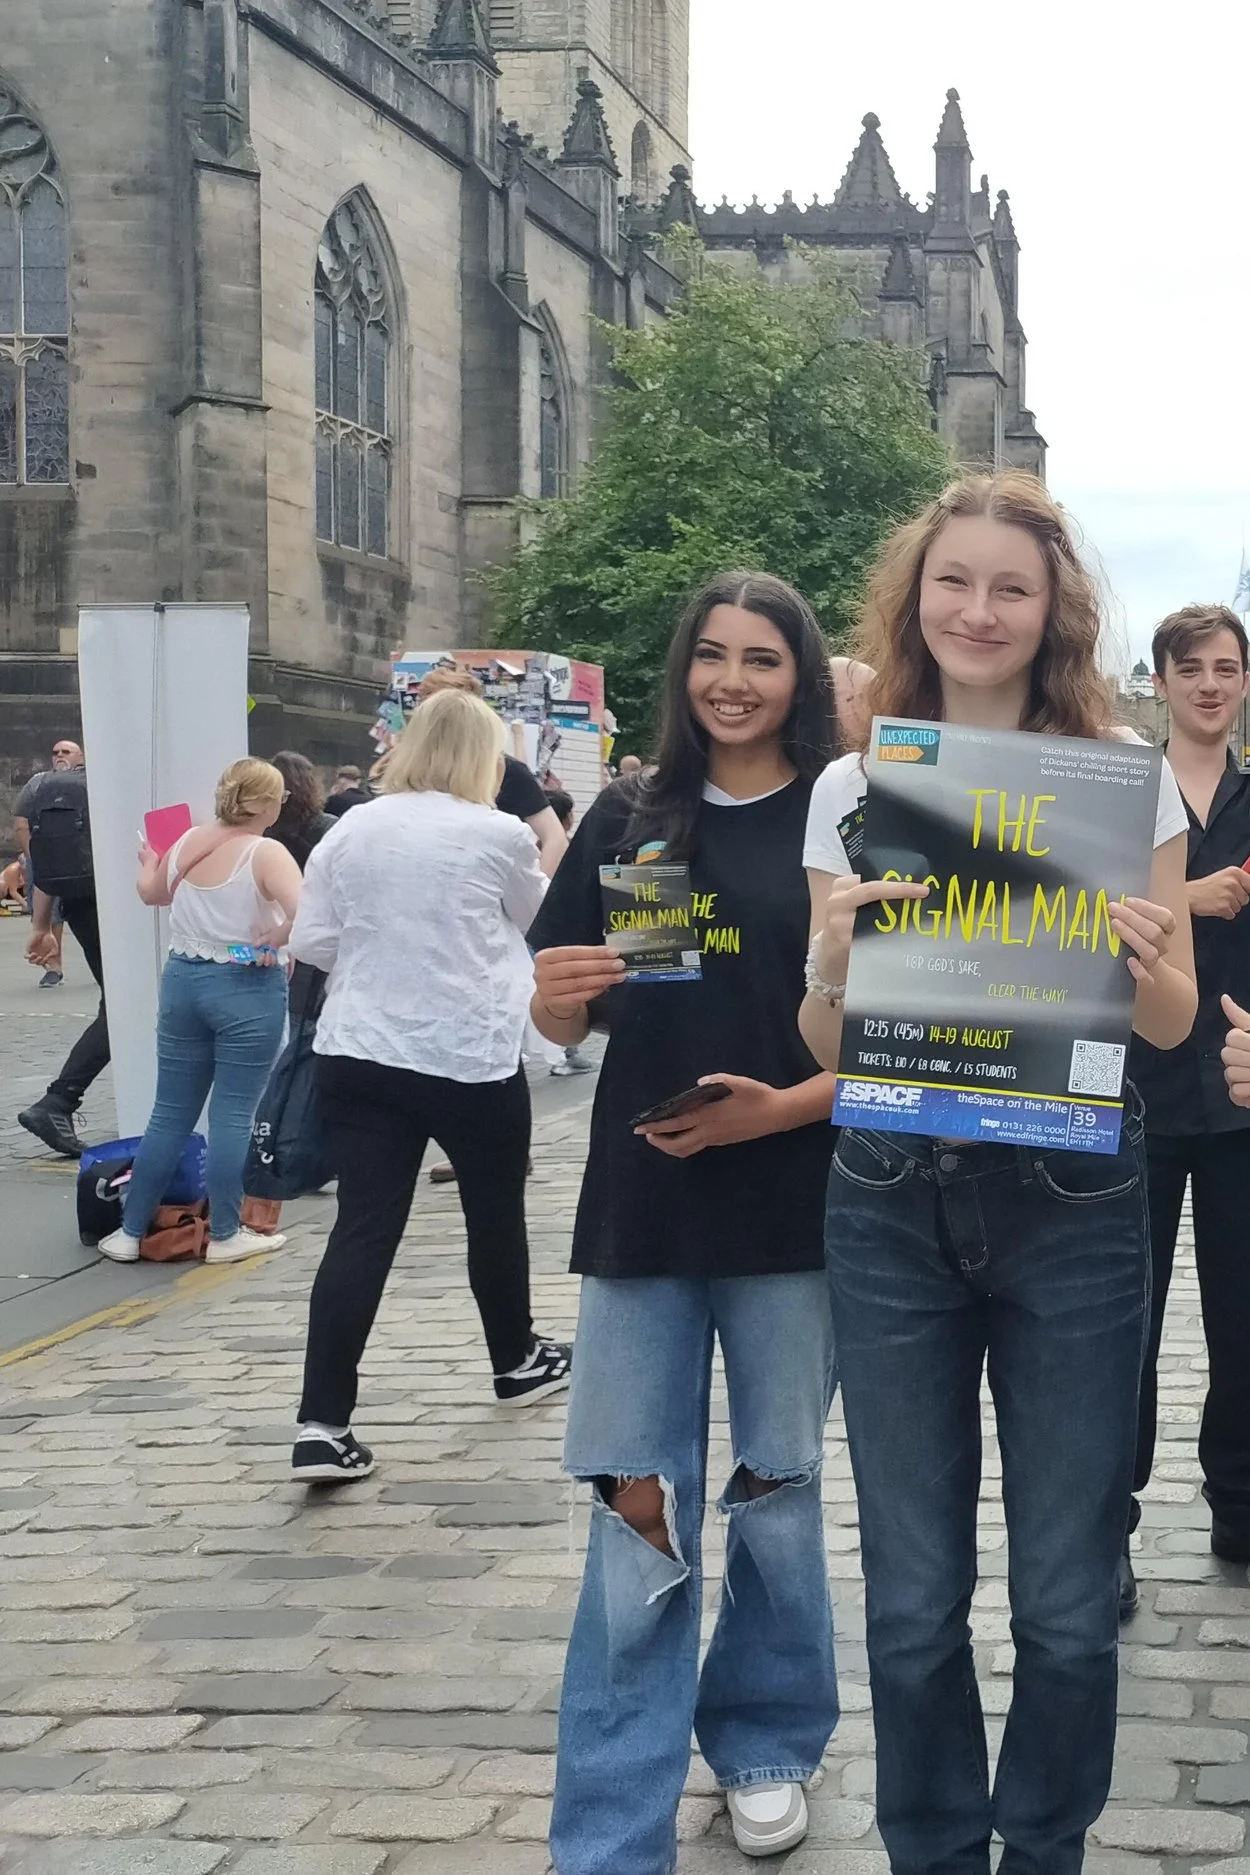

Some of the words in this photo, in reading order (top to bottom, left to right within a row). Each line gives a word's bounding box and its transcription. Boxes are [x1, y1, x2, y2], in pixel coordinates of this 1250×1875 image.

[880, 730, 936, 745] UNEXPECTED
[881, 745, 915, 760] PLACES
[1041, 746, 1064, 756] Catch
[1065, 748, 1079, 758] this
[1080, 750, 1109, 761] original
[1109, 754, 1151, 766] adaptation
[1040, 757, 1048, 765] of
[1080, 761, 1106, 772] chilling
[1107, 764, 1128, 774] short
[1129, 768, 1150, 777] story
[1040, 768, 1065, 778] before
[1066, 770, 1076, 778] its
[1077, 771, 1094, 780] final
[1094, 773, 1128, 786] boarding
[965, 788, 1057, 857] THE
[633, 882, 662, 903] THE
[988, 983, 1016, 998] CLEAR
[1020, 985, 1040, 1000] THE
[863, 1018, 889, 1038] 12:15
[929, 1024, 958, 1045] 14-19
[961, 1027, 1014, 1050] AUGUST
[858, 1051, 893, 1067] TICKETS:
[930, 1059, 952, 1074] CONC.
[975, 1063, 1018, 1080] STUDENTS
[849, 1081, 923, 1106] SPACE
[840, 1101, 920, 1115] www.thespaceuk.com
[957, 1093, 1004, 1107] theSpace
[1008, 1099, 1021, 1109] on
[1024, 1100, 1042, 1111] the
[1045, 1102, 1068, 1114] Mile
[1002, 1121, 1023, 1131] 0131
[1026, 1123, 1042, 1132] 226
[1044, 1125, 1066, 1135] 0000
[1073, 1111, 1096, 1127] 39
[996, 1129, 1065, 1144] www.edfringe.com
